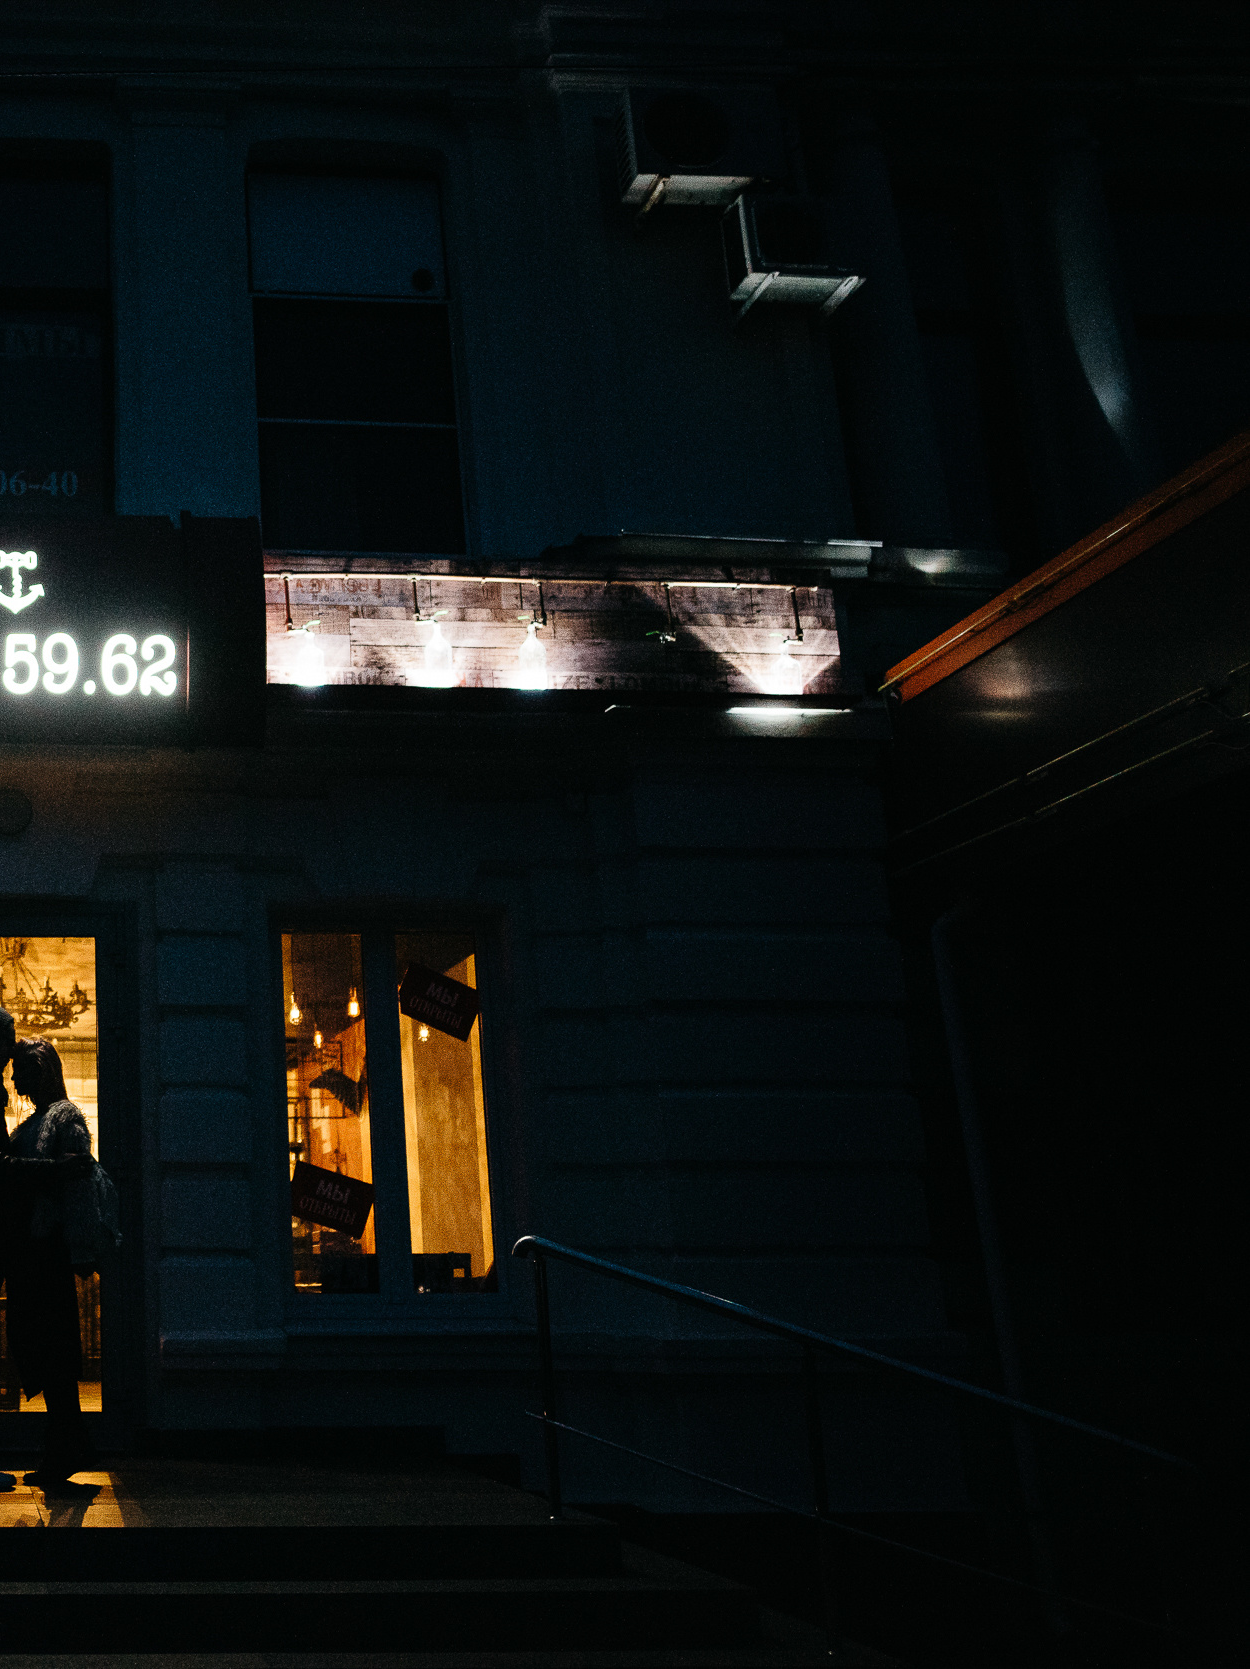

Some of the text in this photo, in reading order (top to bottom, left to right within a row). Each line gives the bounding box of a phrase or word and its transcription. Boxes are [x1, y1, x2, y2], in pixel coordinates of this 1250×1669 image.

[2, 632, 178, 696] 59.62
[426, 981, 459, 1008] МЫ
[409, 996, 464, 1030] ОТКРЫТЫ
[316, 1178, 350, 1204] МЫ
[299, 1196, 357, 1226] ОТКРЫТЫ
